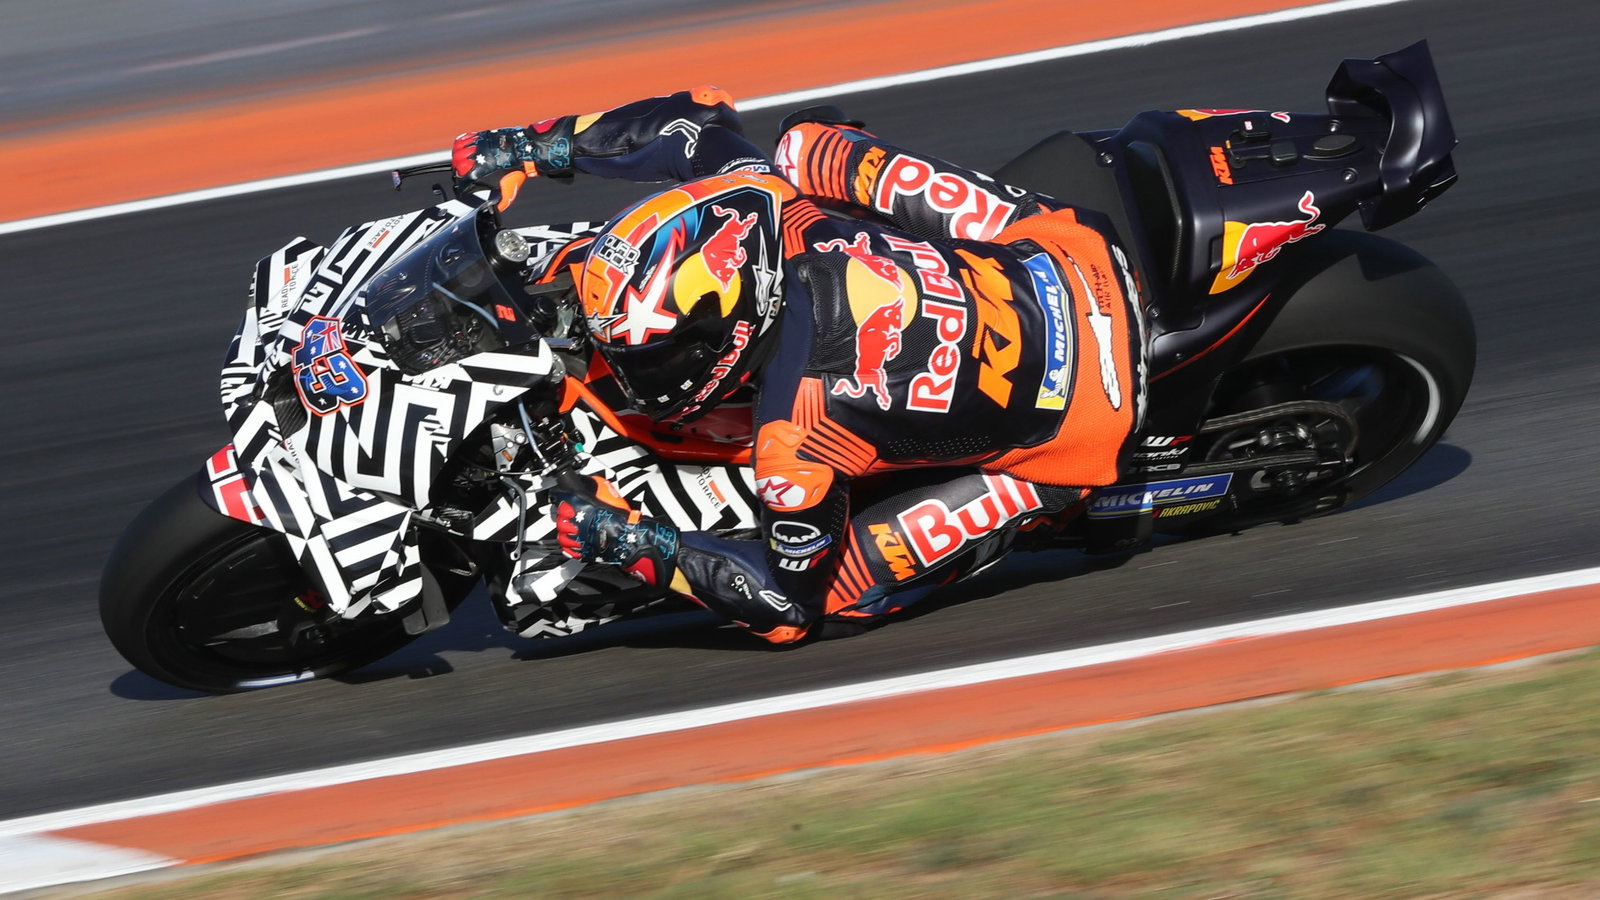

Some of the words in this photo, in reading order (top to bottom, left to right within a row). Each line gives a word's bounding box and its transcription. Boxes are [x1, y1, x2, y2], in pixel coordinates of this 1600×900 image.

[853, 146, 887, 206] KTM
[1209, 147, 1234, 185] KTM
[875, 153, 1017, 242] Red
[598, 246, 640, 275] LOCK
[604, 236, 641, 262] QUAD
[880, 233, 966, 303] Bull
[716, 320, 750, 367] Bull
[954, 249, 1022, 409] KTM
[292, 315, 369, 416] 43
[906, 299, 967, 414] Red
[1141, 435, 1193, 447] WP
[702, 485, 721, 509] RACE
[1094, 484, 1214, 507] MICHELIN
[896, 473, 1043, 568] Bull
[779, 548, 829, 571] WP
[784, 540, 826, 555] MICHELIN
[867, 523, 917, 581] KTM
